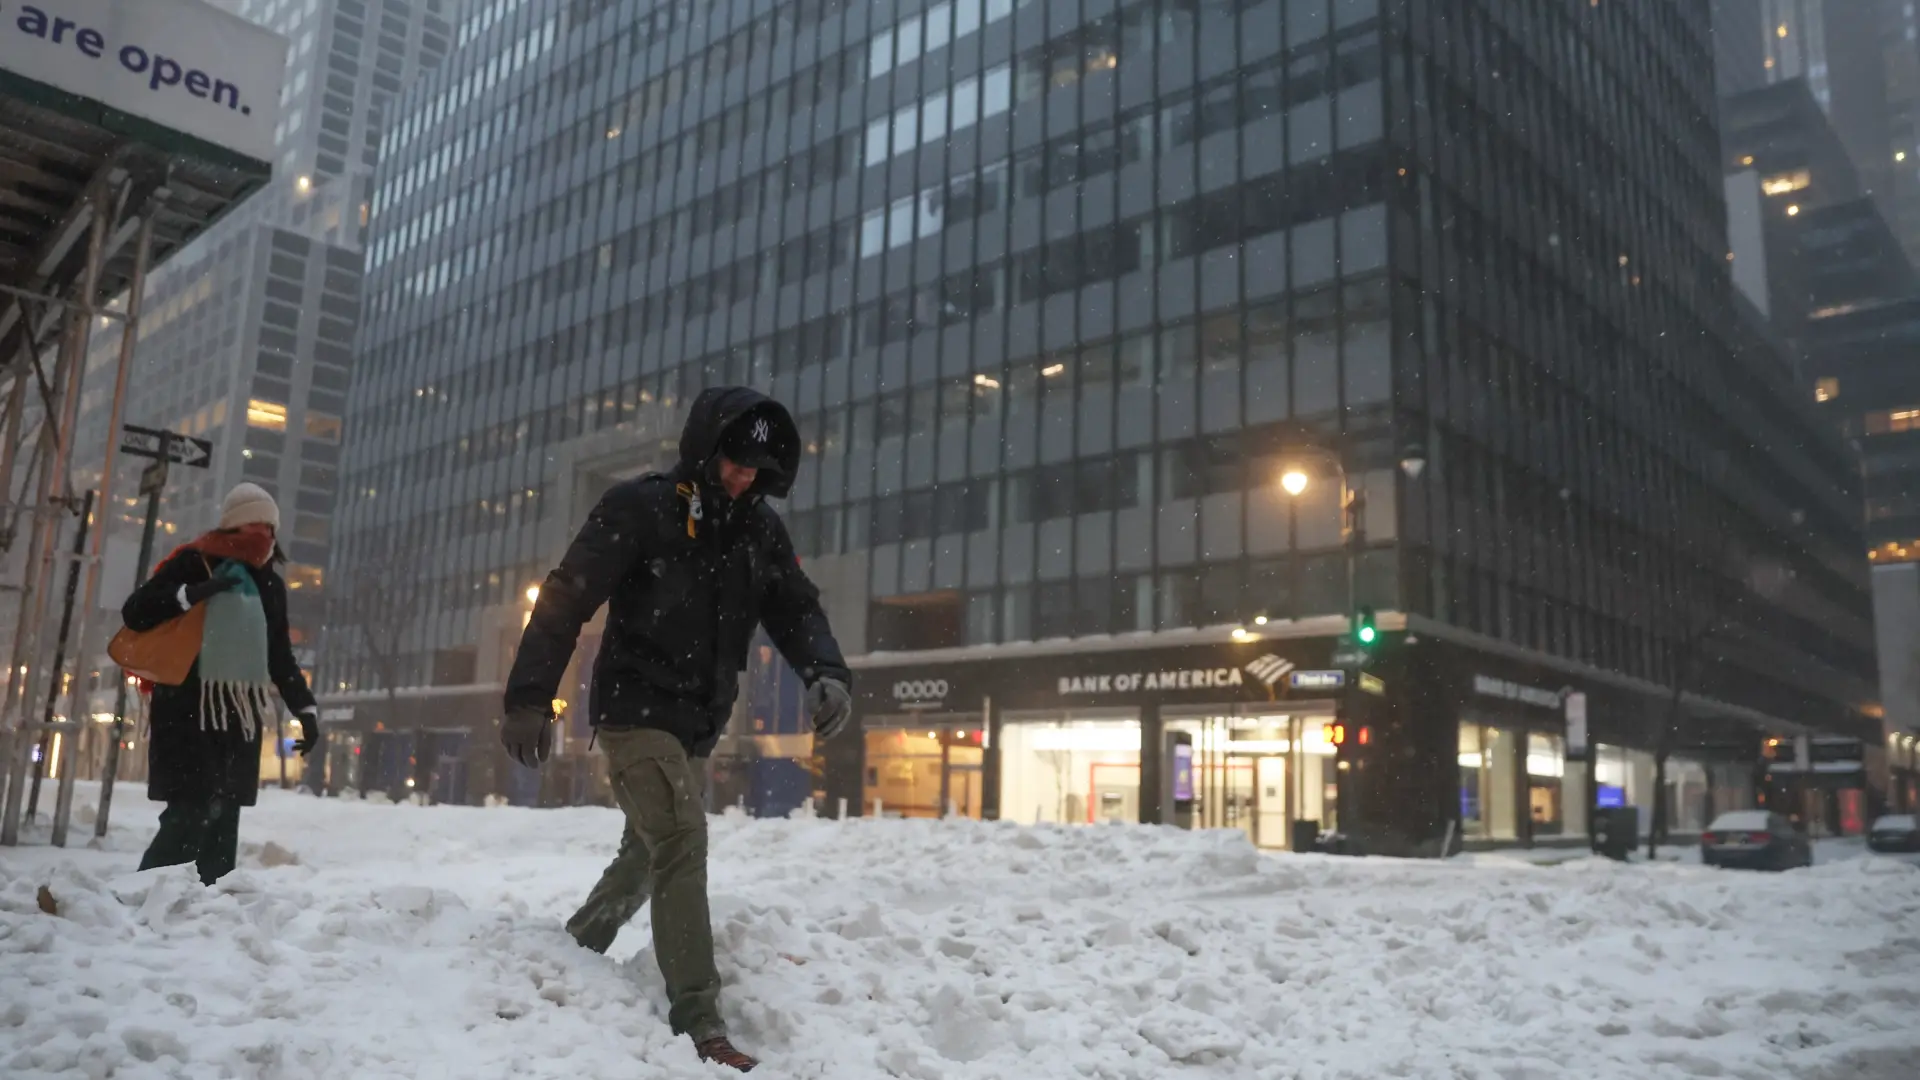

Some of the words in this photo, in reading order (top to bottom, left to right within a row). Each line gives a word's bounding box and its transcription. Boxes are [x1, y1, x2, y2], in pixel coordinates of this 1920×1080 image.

[16, 4, 105, 58] are
[119, 44, 252, 116] open.
[124, 433, 150, 450] ONE
[752, 418, 769, 443] NY
[1058, 674, 1110, 694] BANK
[1115, 672, 1141, 691] OF
[1145, 667, 1243, 689] AMERICA
